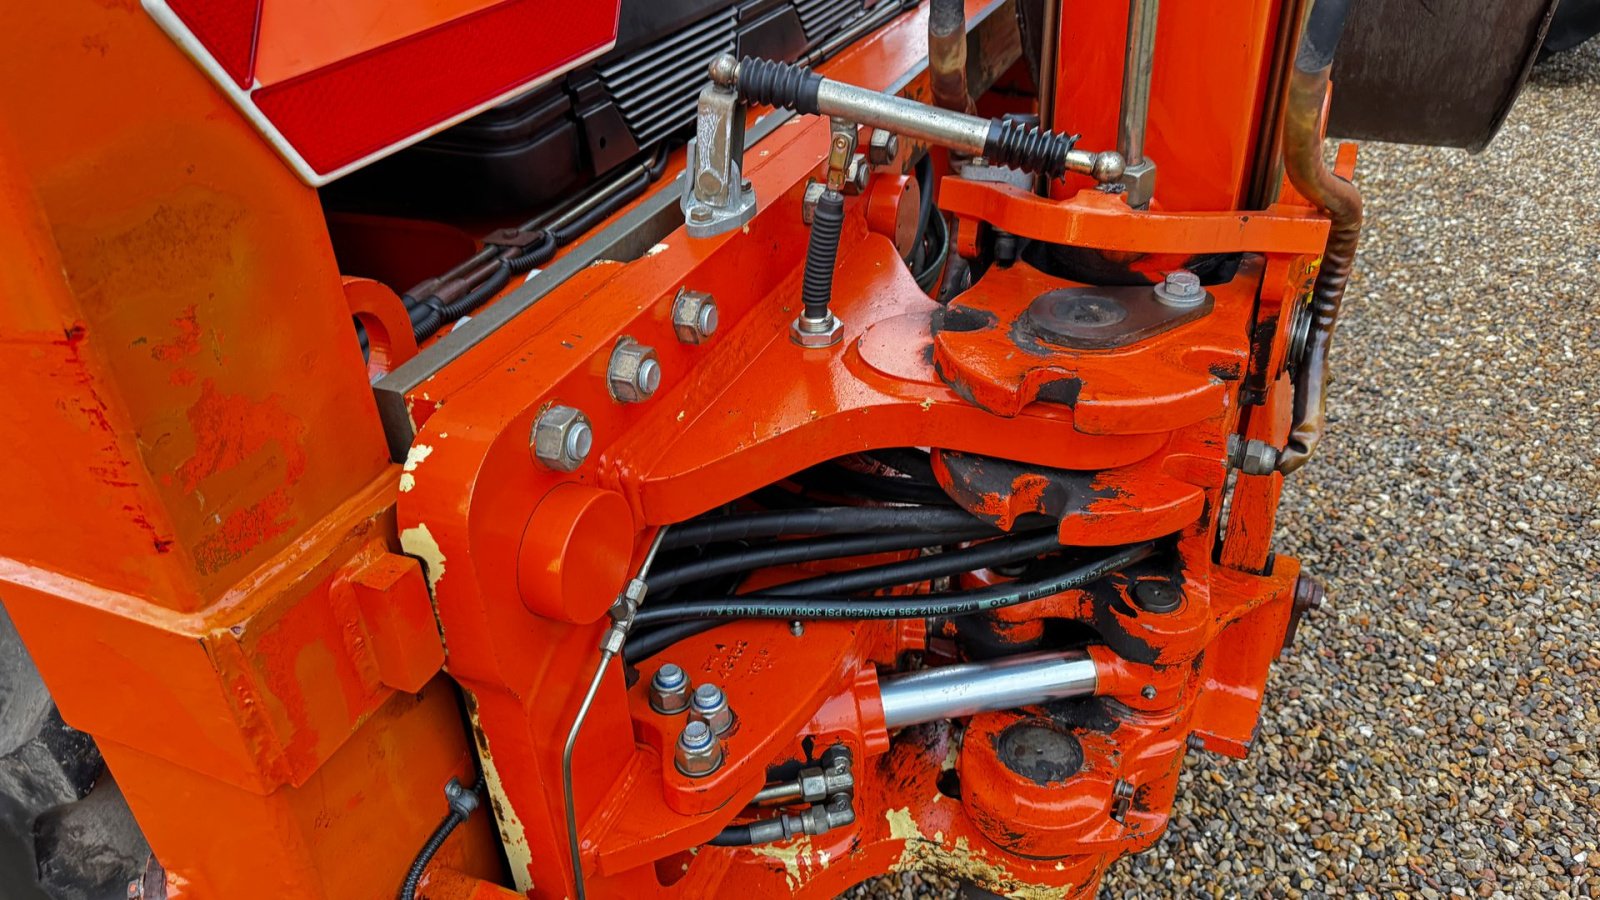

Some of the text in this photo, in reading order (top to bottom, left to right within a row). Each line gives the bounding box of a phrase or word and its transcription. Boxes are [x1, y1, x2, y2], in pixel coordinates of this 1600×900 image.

[714, 606, 744, 616] U.S.A.
[747, 606, 758, 616] IN
[761, 606, 793, 616] MADE
[824, 607, 842, 617] PSI
[845, 607, 896, 617] BAR/4250
[898, 608, 918, 616] 295
[920, 605, 949, 615] DN12
